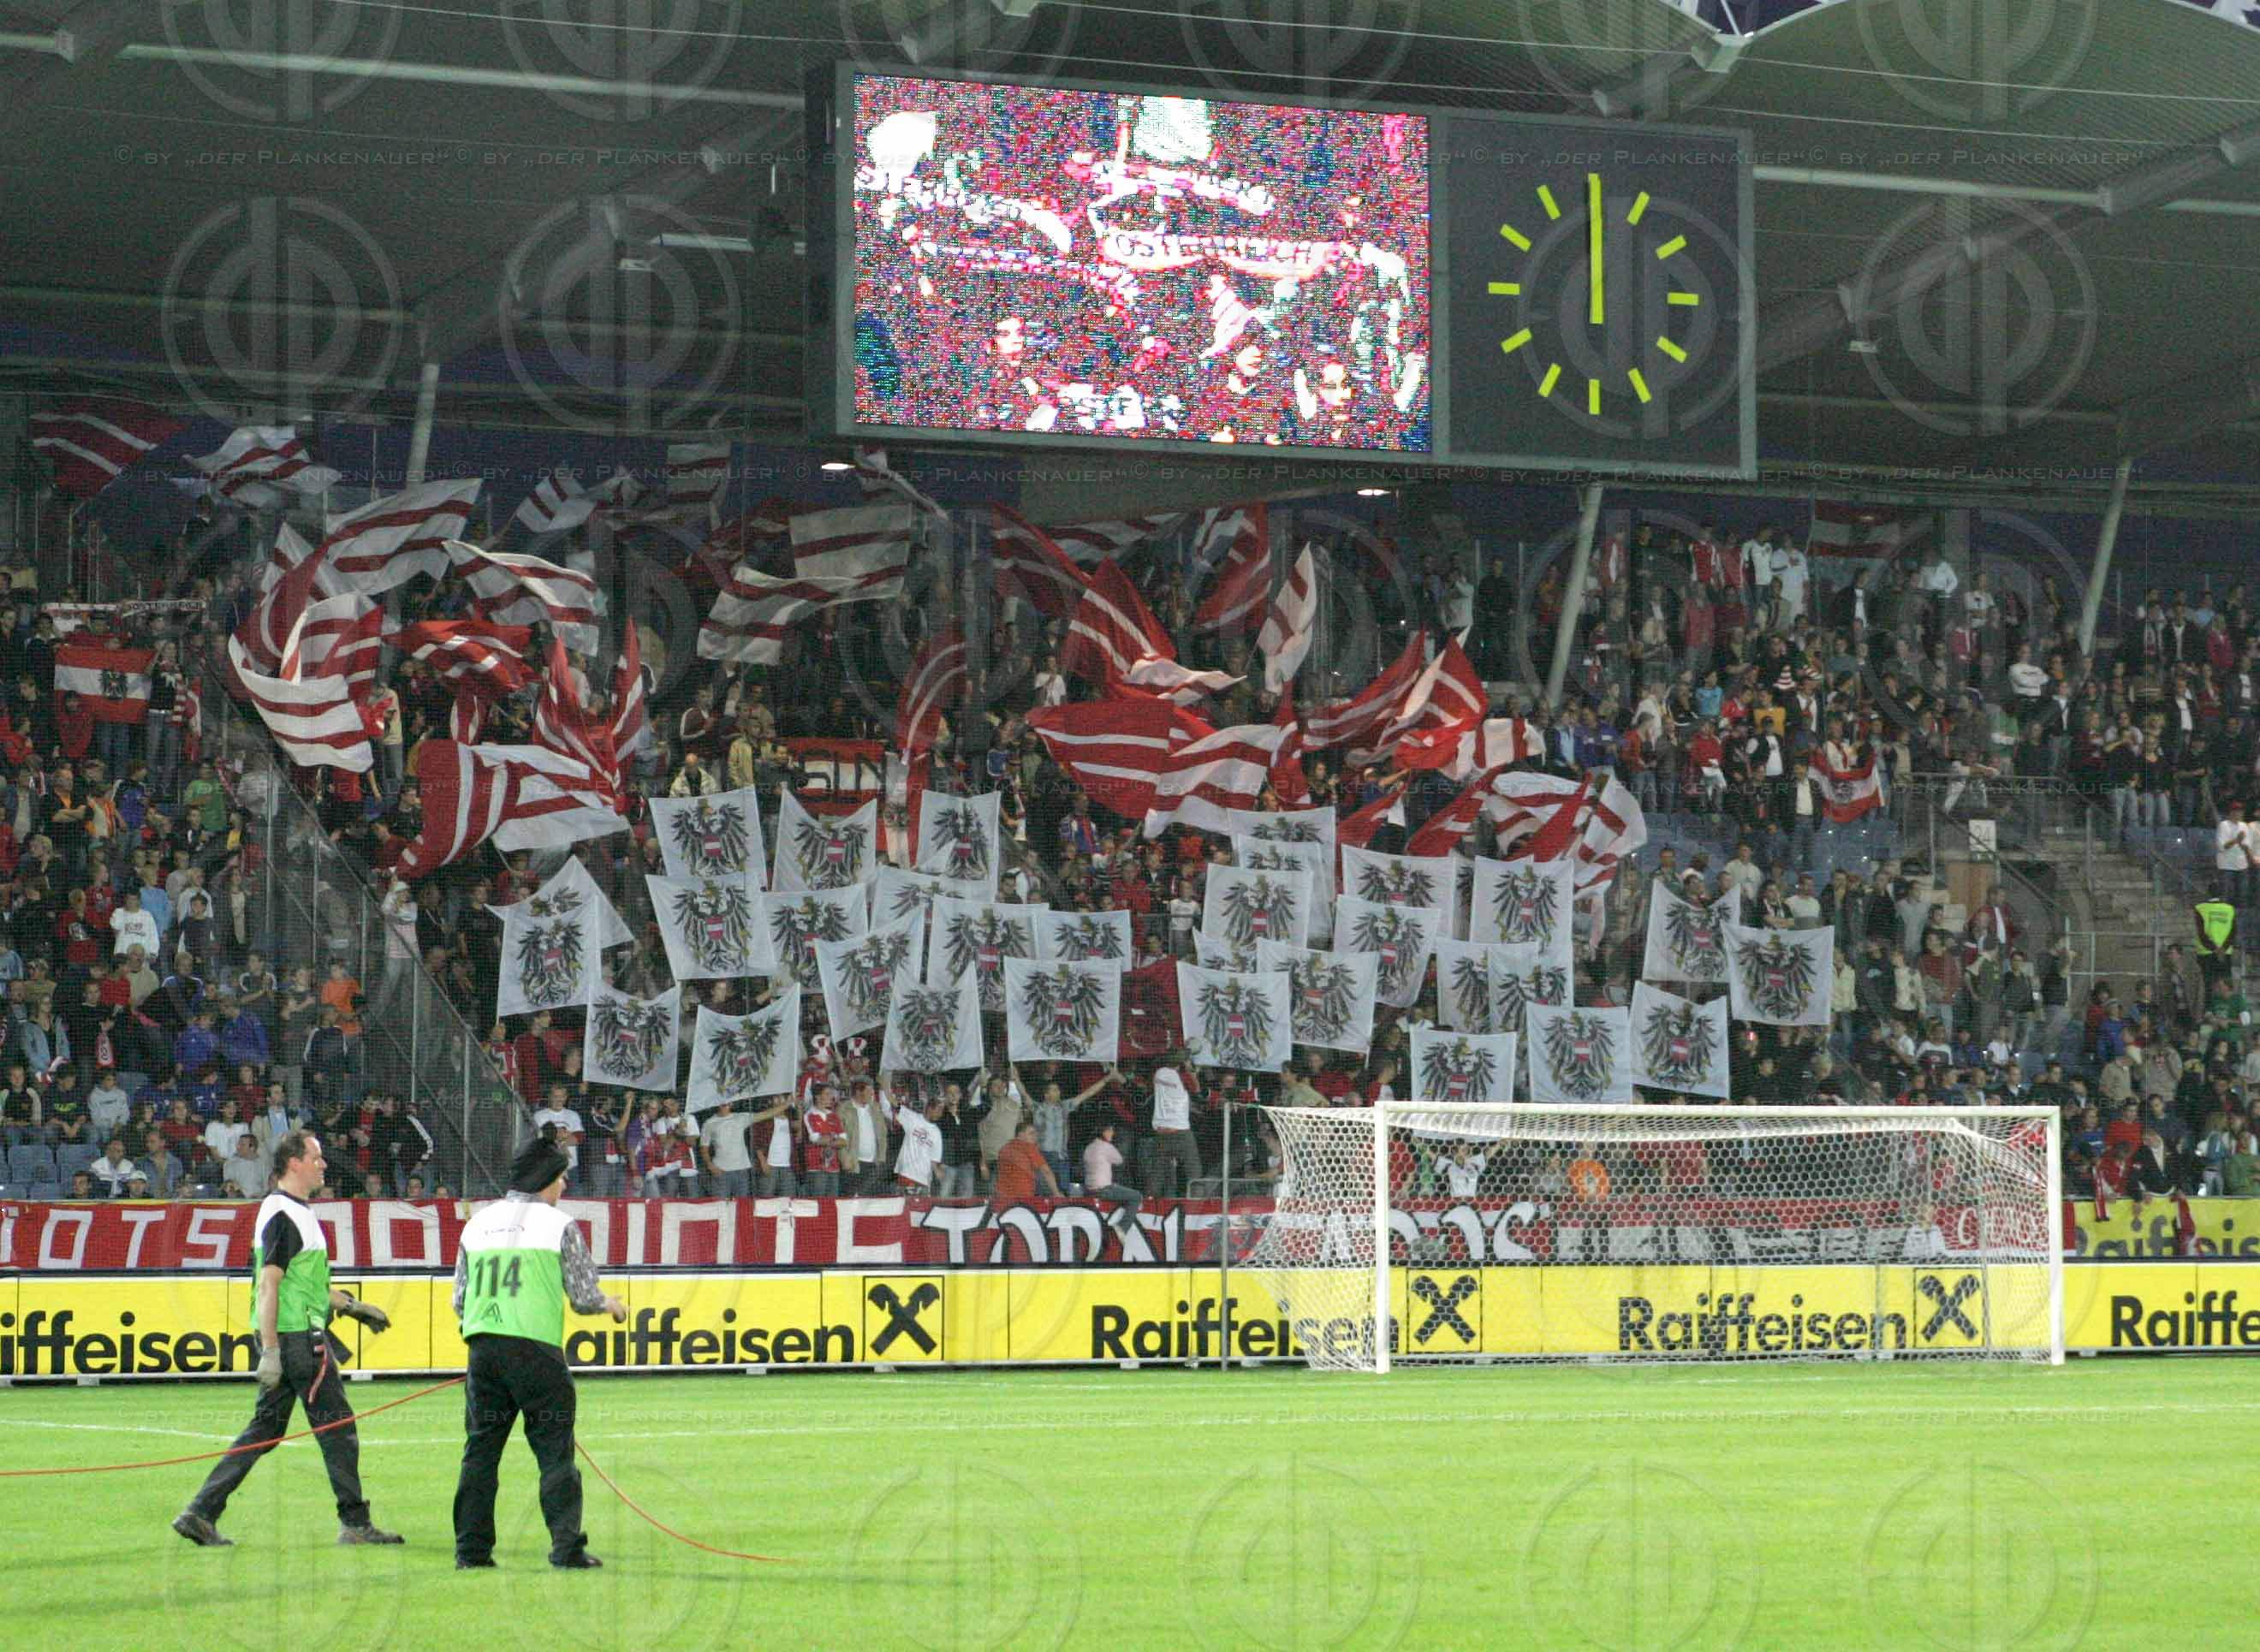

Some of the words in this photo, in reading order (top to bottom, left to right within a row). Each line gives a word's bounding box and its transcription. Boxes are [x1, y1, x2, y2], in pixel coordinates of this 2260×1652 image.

[473, 1254, 523, 1298] 114
[565, 1307, 854, 1365] aiffeisen
[1619, 1292, 1906, 1352] Raiffeisen
